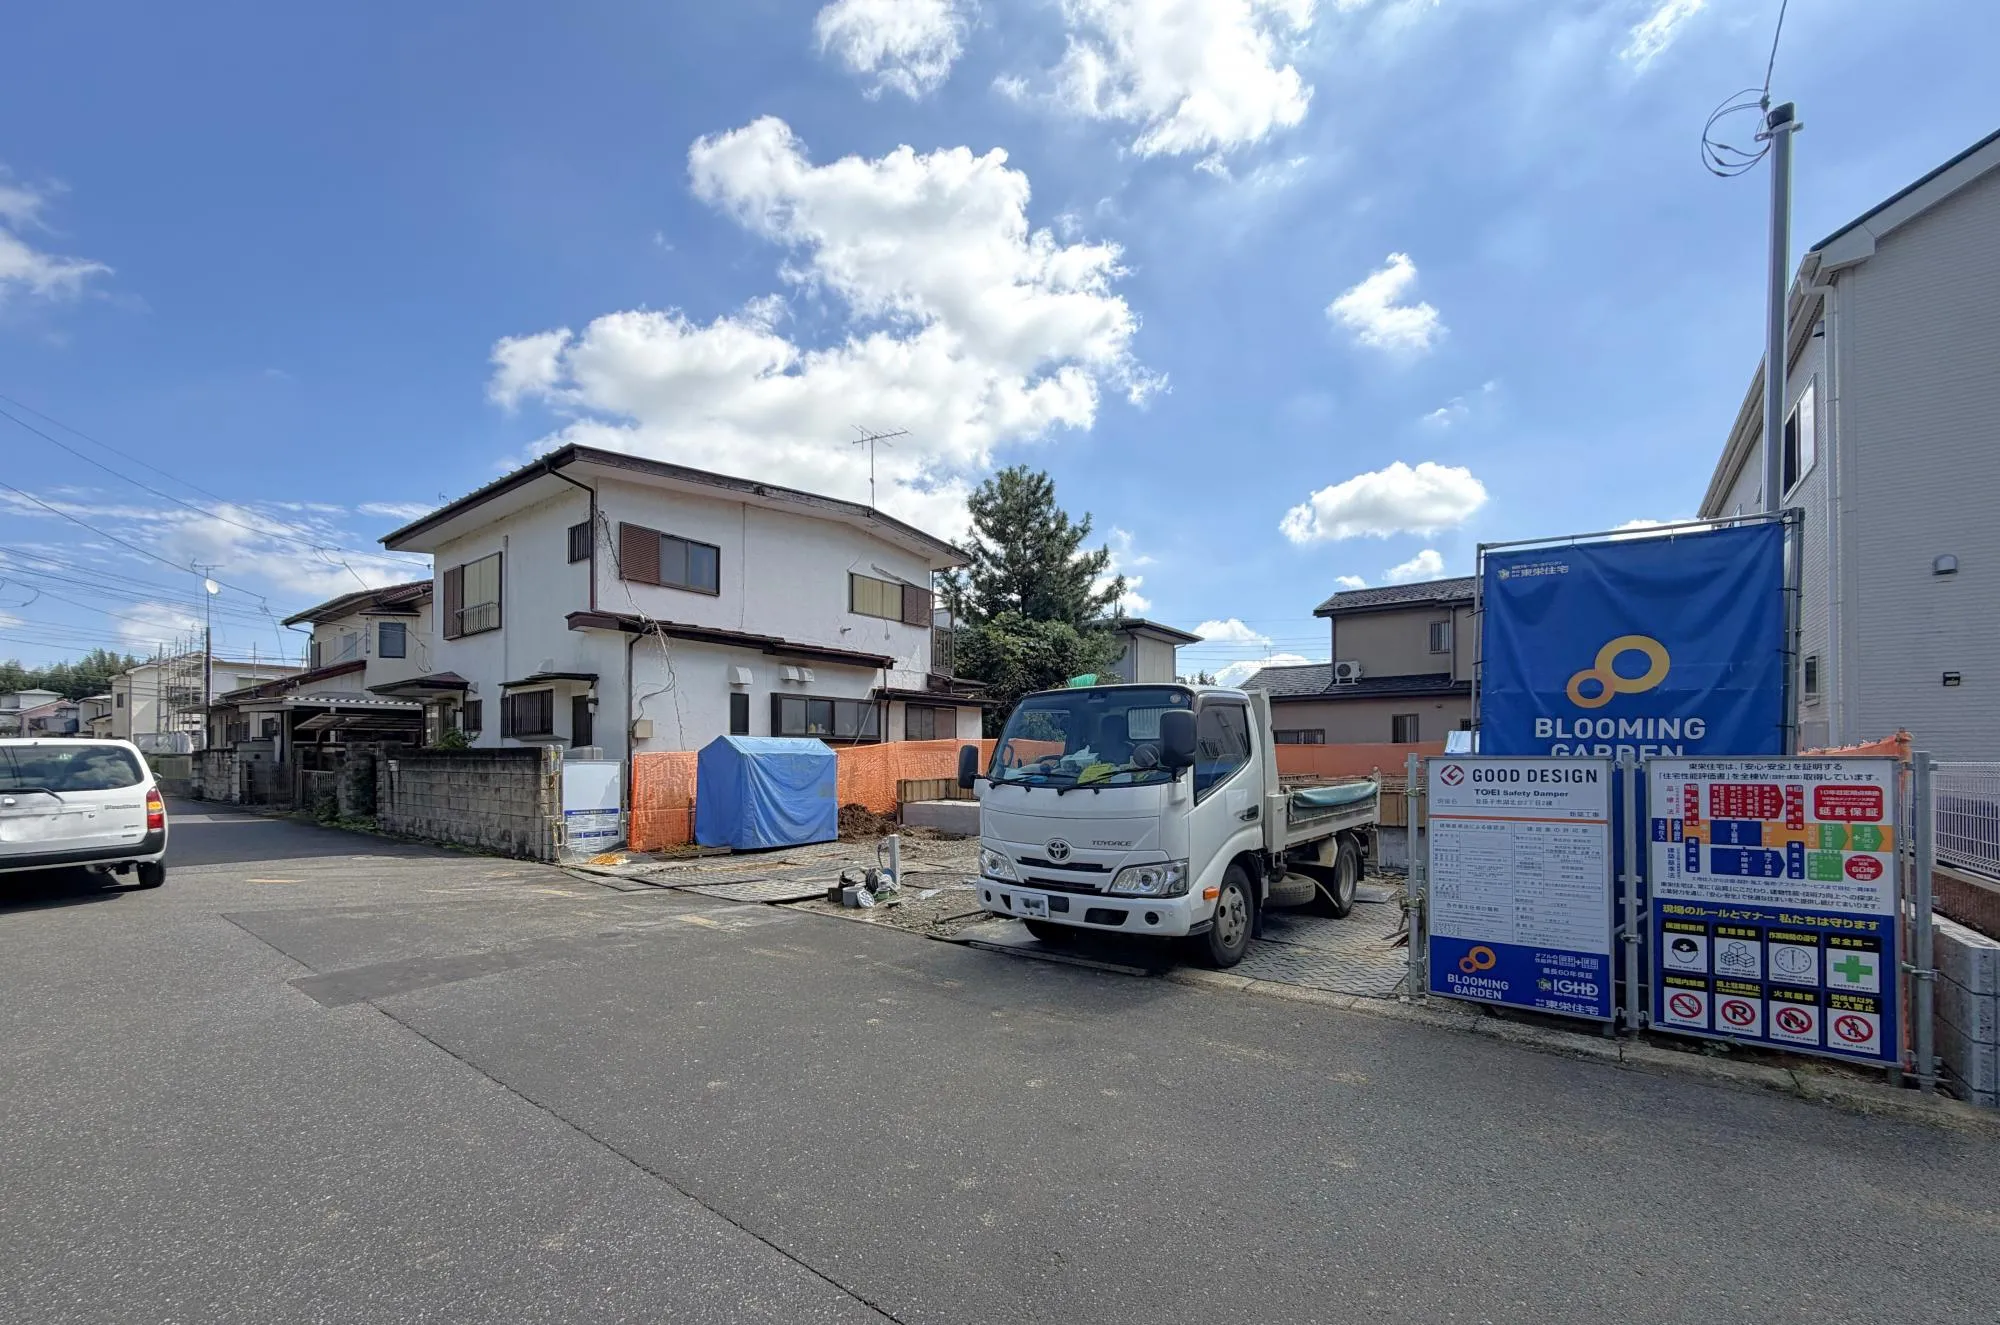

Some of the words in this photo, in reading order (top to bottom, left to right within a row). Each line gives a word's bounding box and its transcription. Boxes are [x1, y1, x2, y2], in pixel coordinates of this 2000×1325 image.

[1535, 717, 1706, 740] BLOOMING
[1472, 769, 1520, 783] GOOD
[1527, 769, 1598, 783] DESIGN
[1503, 790, 1531, 798] Safety
[1533, 790, 1569, 798] Damper
[1662, 904, 1776, 920] 現場のルールとマナー
[1779, 913, 1880, 931] 私たちは守ります
[1447, 973, 1510, 991] BLOOMING
[1553, 979, 1599, 996] IGHD
[1453, 984, 1502, 1000] GARDEN
[1546, 999, 1600, 1016] 東栄住宅
